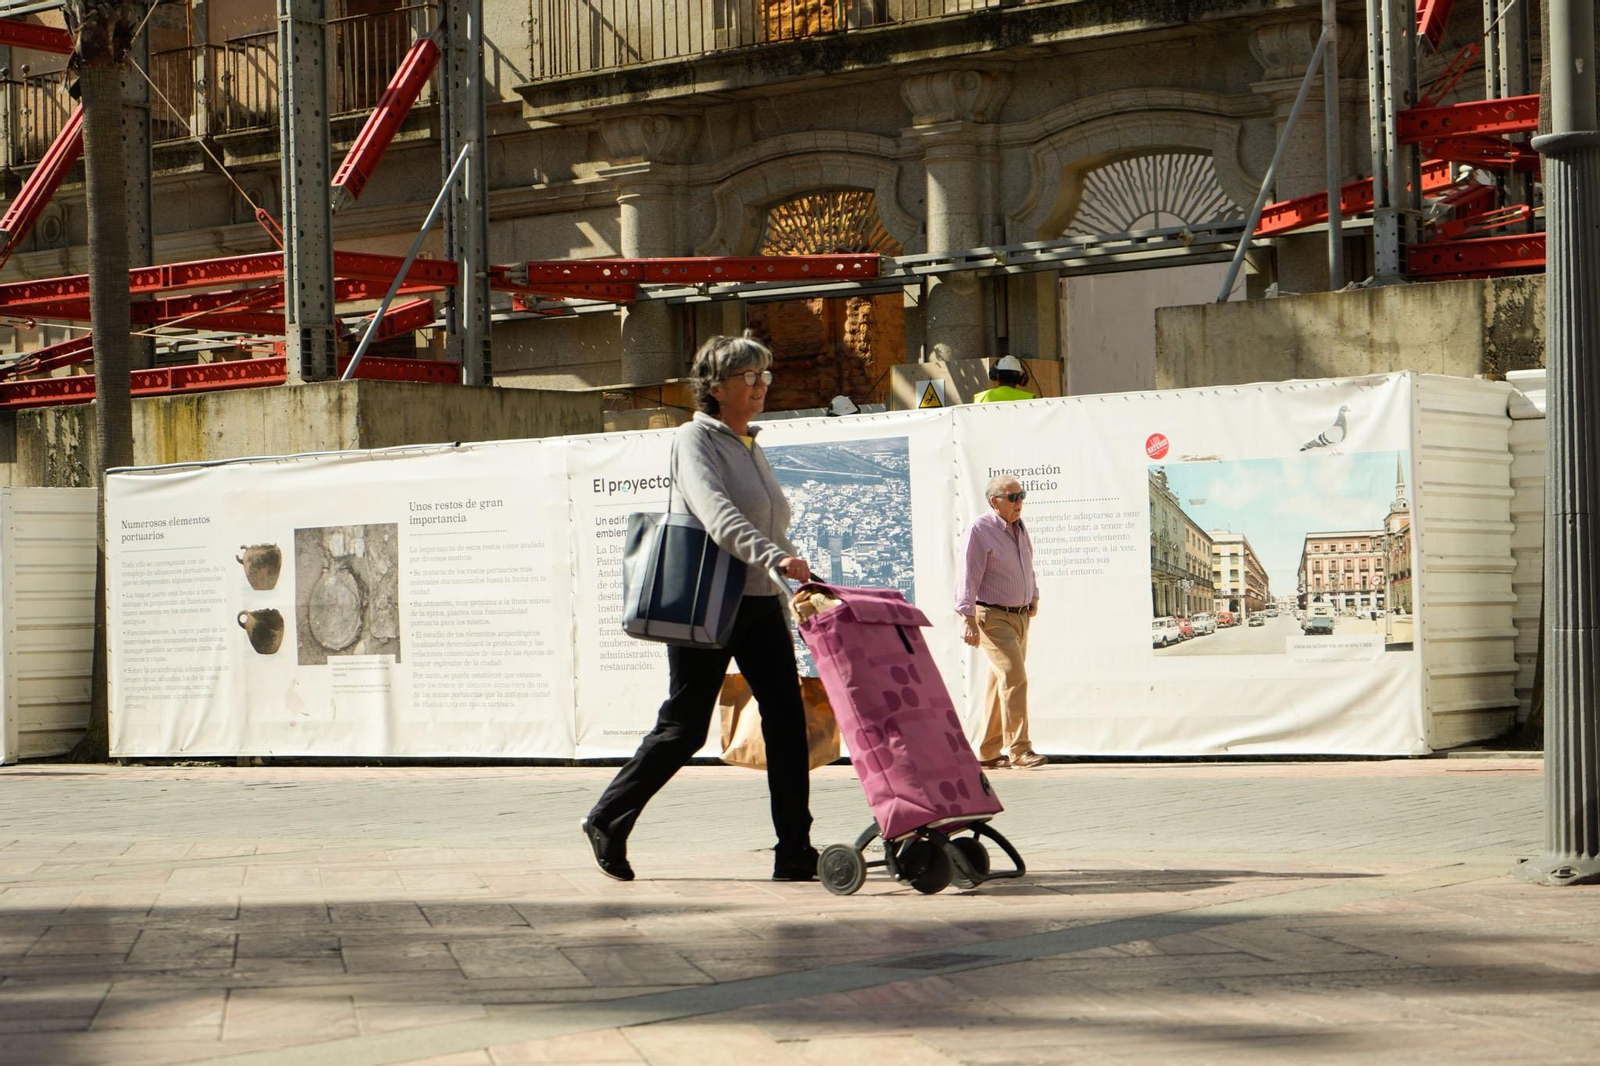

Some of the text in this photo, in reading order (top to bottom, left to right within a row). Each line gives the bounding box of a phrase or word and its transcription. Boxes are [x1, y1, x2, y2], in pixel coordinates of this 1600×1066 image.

[988, 464, 1061, 478] Integración
[593, 475, 671, 496] El proyecto
[1020, 480, 1058, 492] dificio
[409, 499, 503, 511] Unos restos de gran
[409, 513, 467, 527] importancia
[596, 515, 628, 525] Un edifi
[1036, 511, 1071, 523] pretende
[1073, 509, 1113, 521] adaptarse
[1123, 509, 1140, 517] este
[121, 516, 210, 530] Numerosos elementos
[1029, 524, 1055, 535] ncepto
[1054, 523, 1066, 532] de
[1067, 522, 1091, 534] lugar,
[1101, 521, 1123, 530] tenor
[1125, 520, 1136, 529] de
[121, 531, 164, 544] portuarios
[596, 528, 628, 538] emblem
[1033, 534, 1067, 545] factores,
[1093, 531, 1131, 541] elemento
[597, 546, 606, 554] La
[1038, 545, 1081, 557] integrador
[1082, 547, 1100, 555] que,
[1108, 543, 1117, 552] la
[597, 557, 623, 566] Patrim
[1051, 555, 1094, 567] mejorando
[1042, 567, 1054, 576] las
[1055, 567, 1068, 576] del
[1070, 566, 1105, 575] entorno.
[598, 592, 623, 600] destin
[598, 604, 624, 612] institu
[600, 650, 662, 659] administrativo,
[600, 662, 655, 671] restauración.
